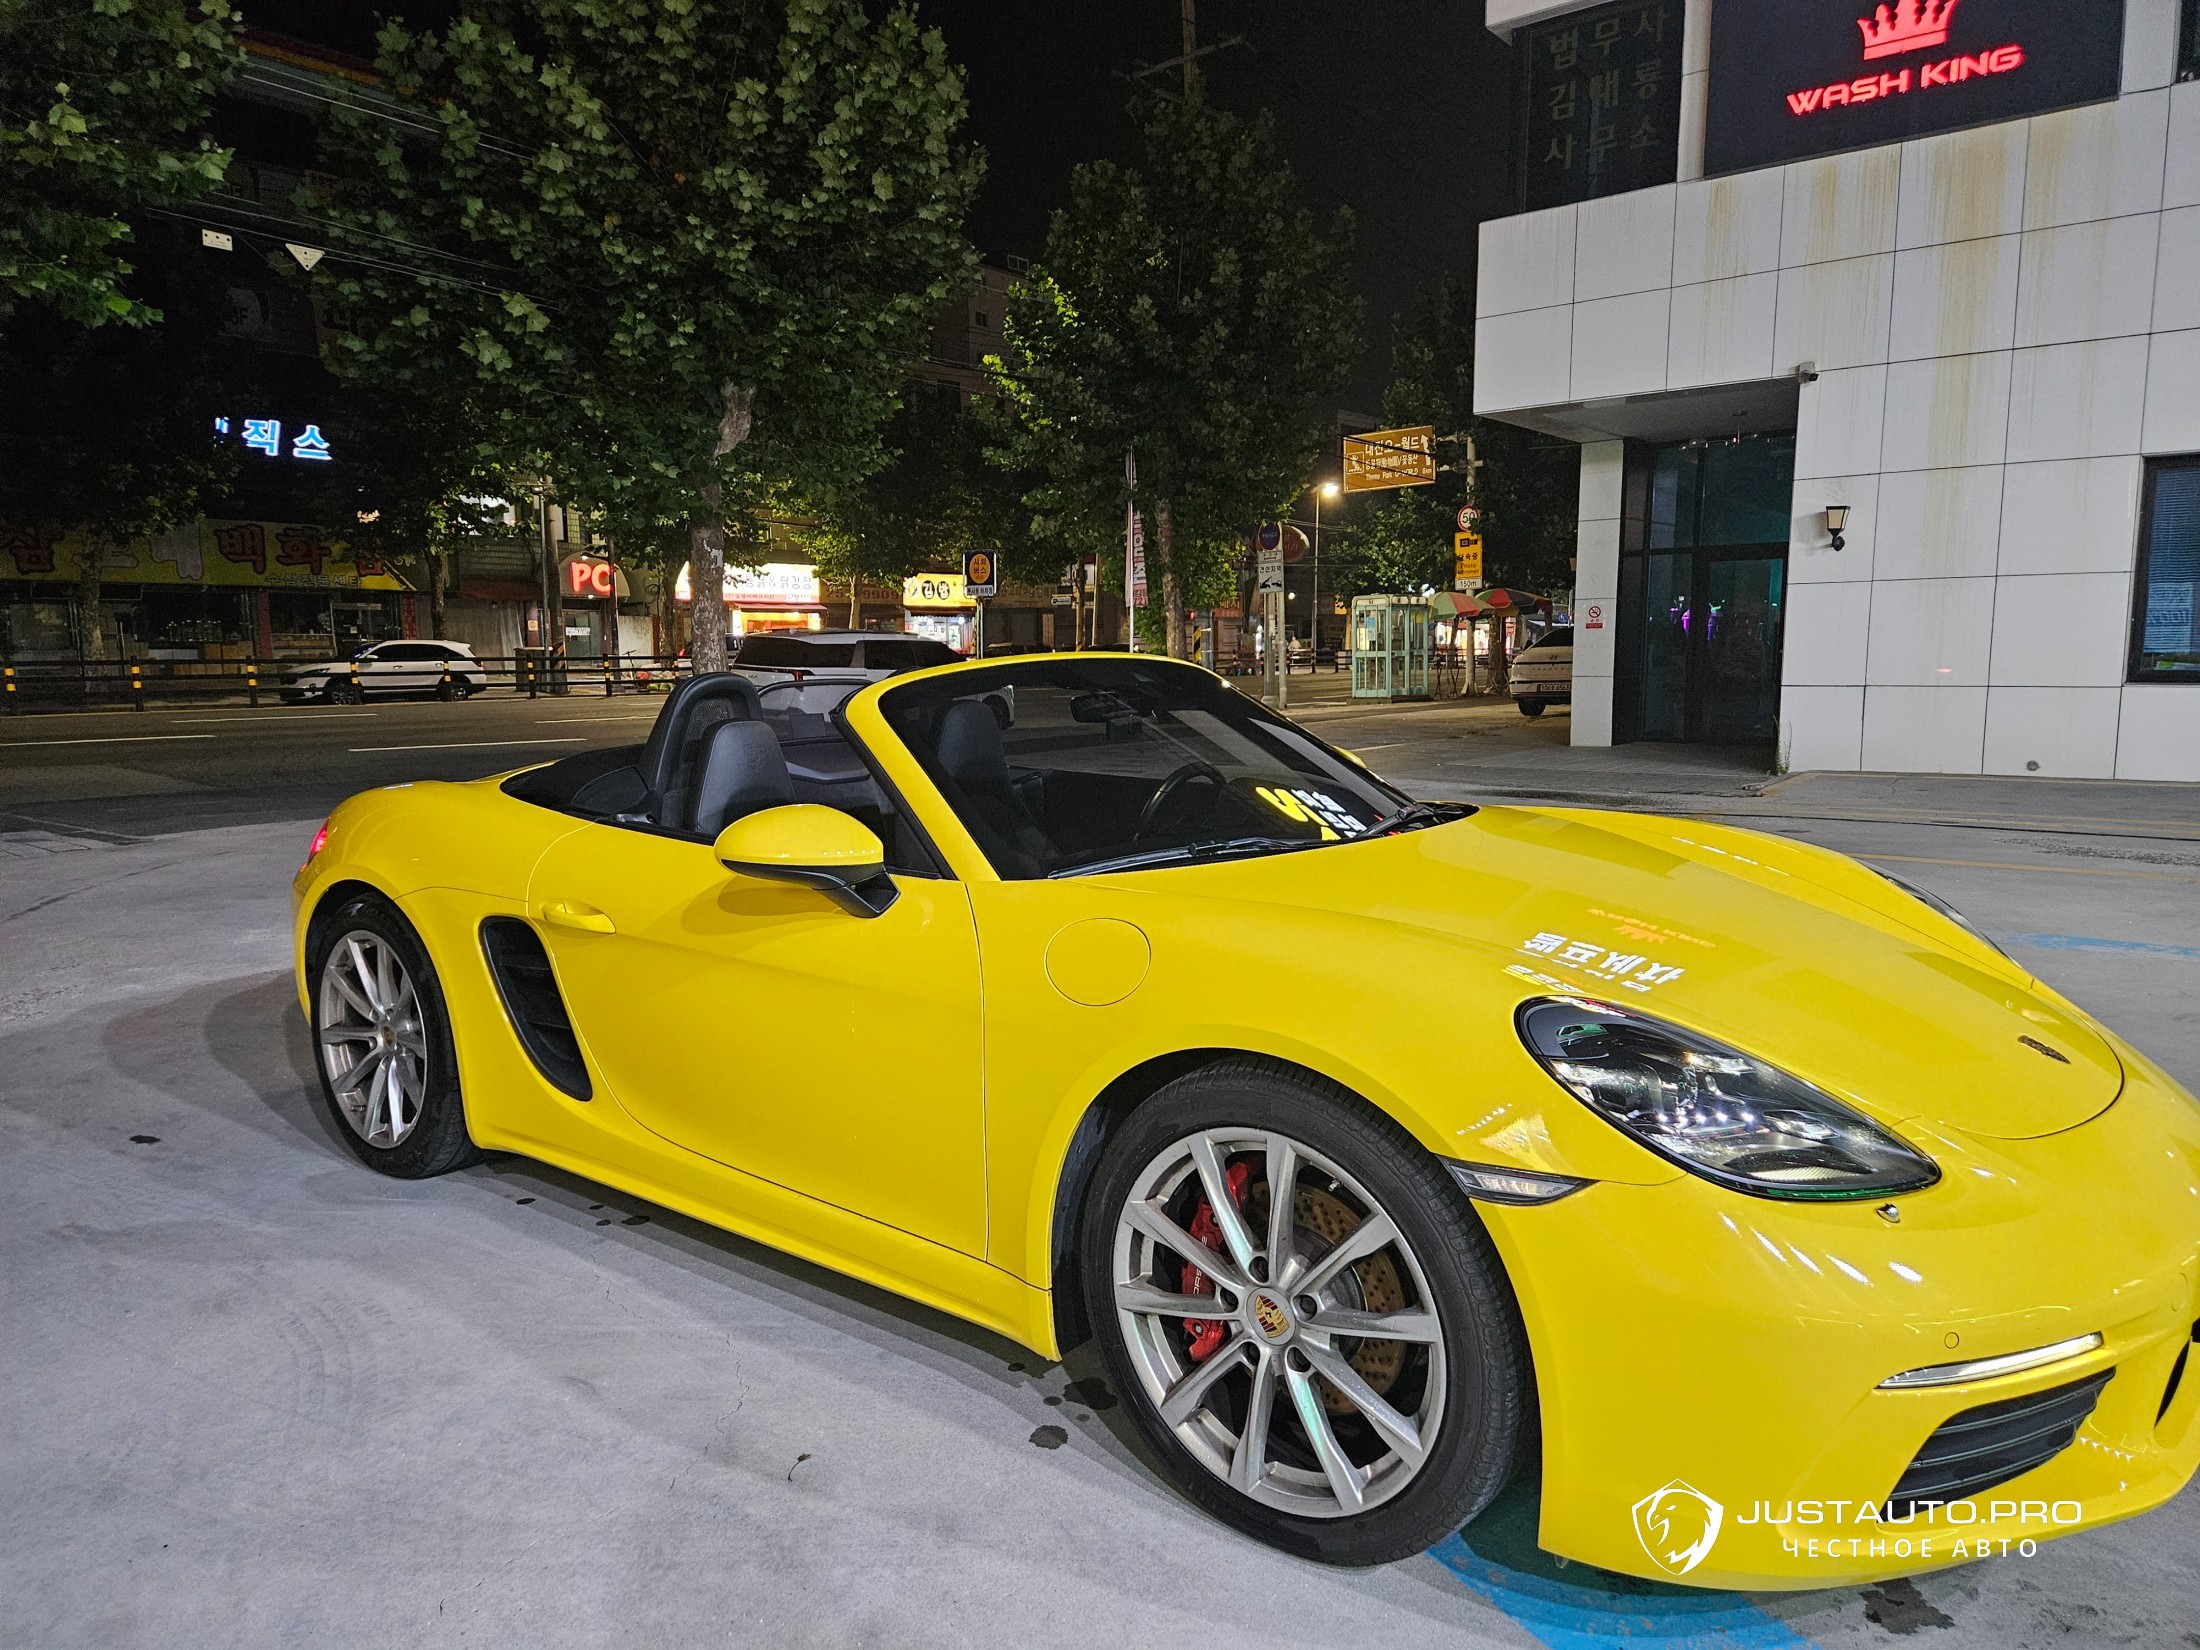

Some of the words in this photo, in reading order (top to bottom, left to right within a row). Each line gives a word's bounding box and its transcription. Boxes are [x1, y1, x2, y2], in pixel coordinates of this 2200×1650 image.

[1786, 68, 1912, 116] WASH
[1920, 43, 2025, 88] KING
[973, 557, 987, 566] 시외
[570, 561, 612, 593] PC
[973, 566, 987, 574] 버스
[921, 580, 950, 600] 김밥
[1460, 580, 1477, 588] 150m
